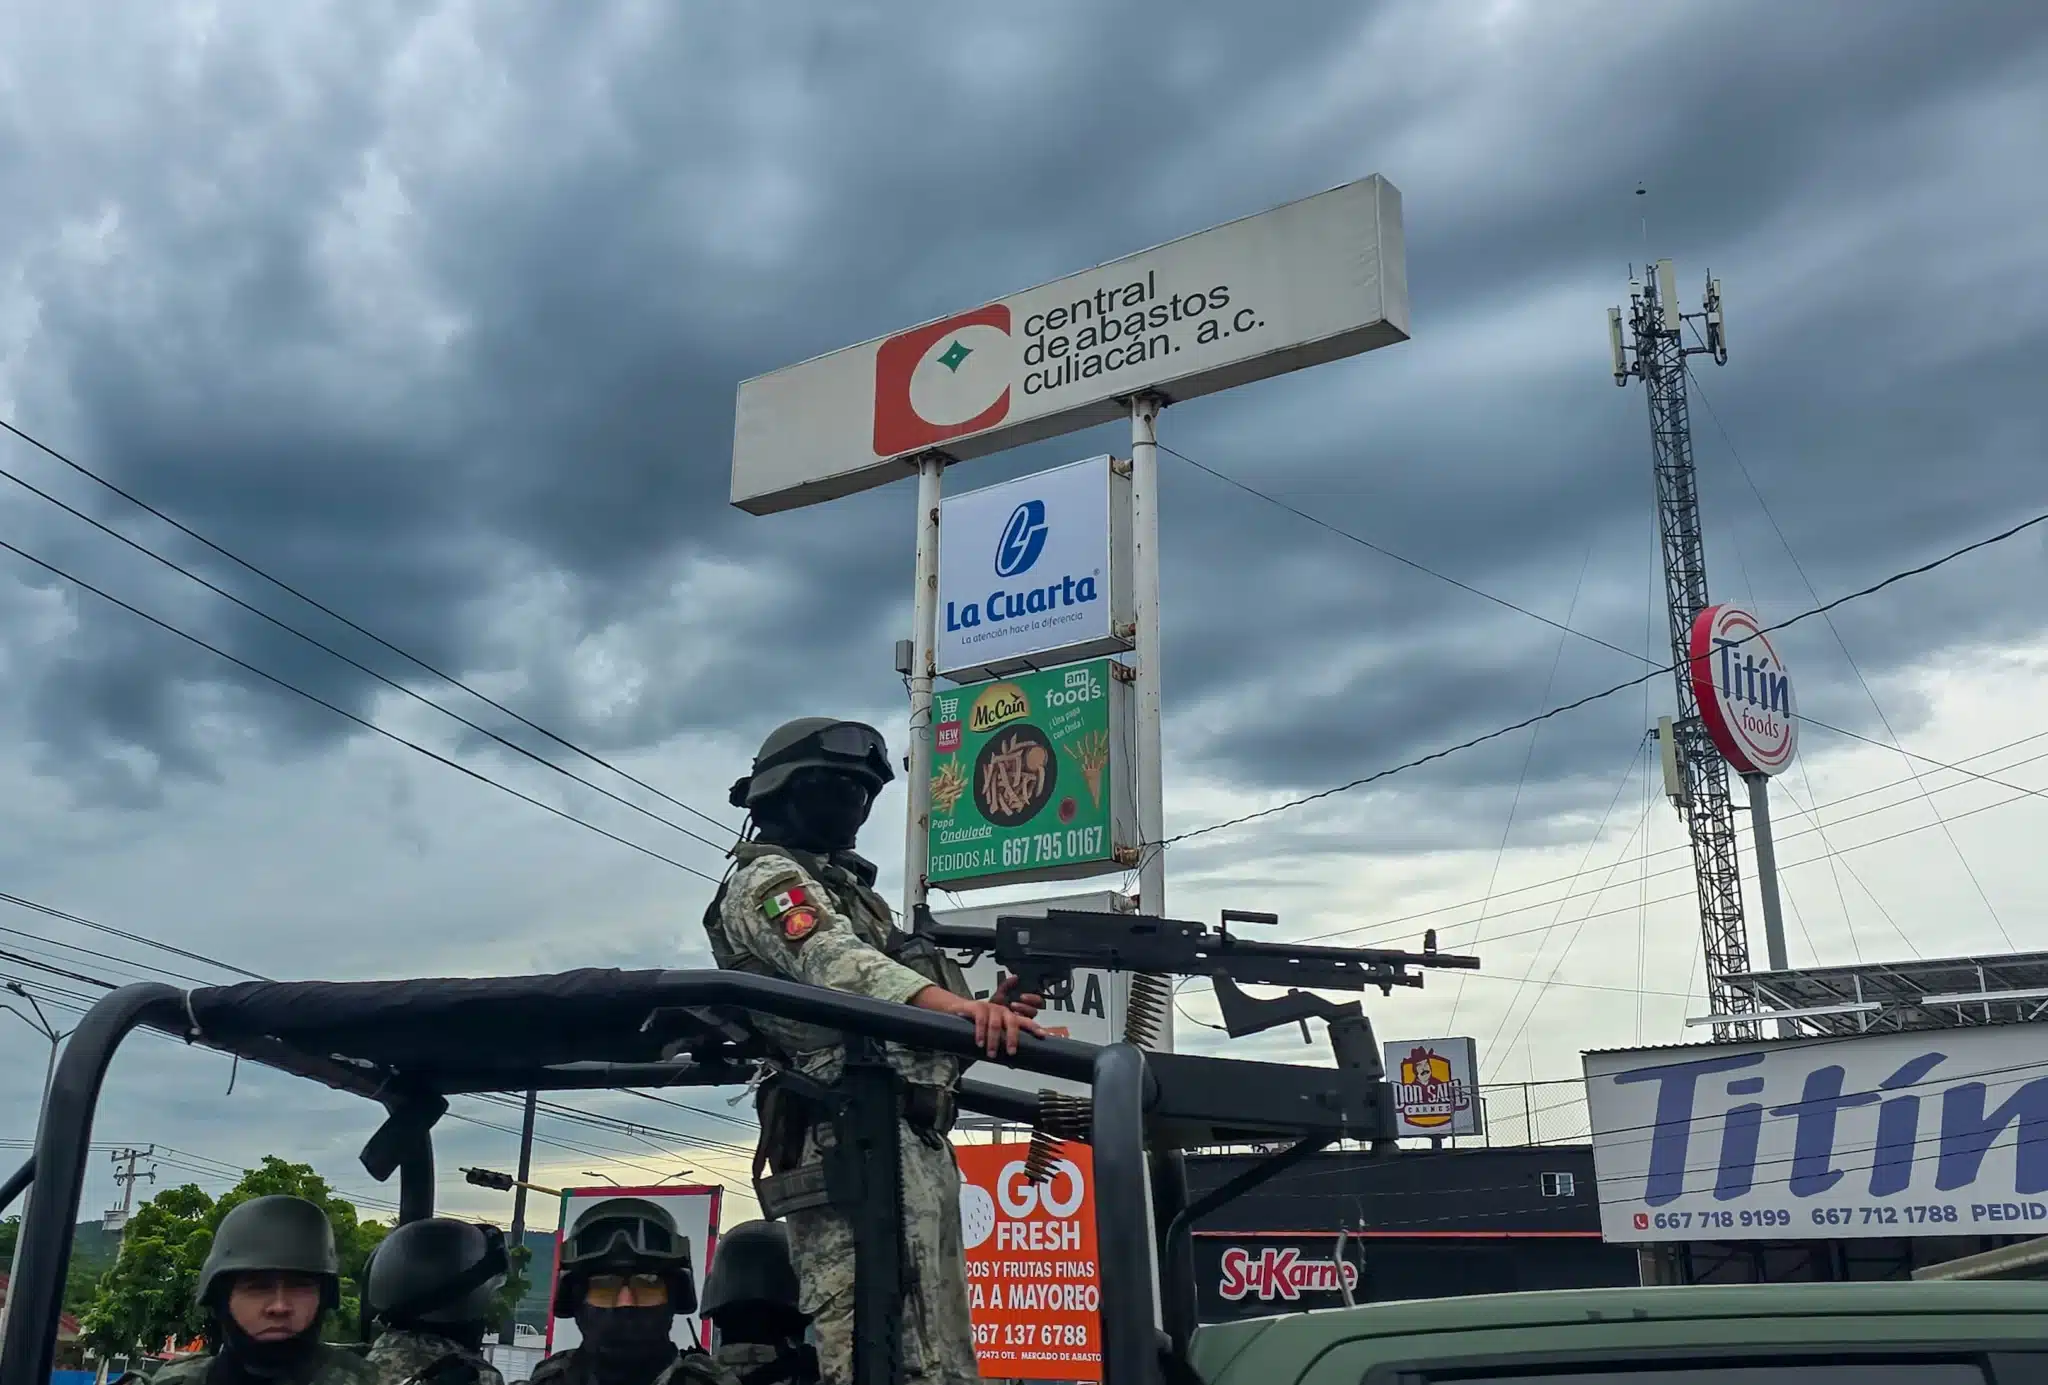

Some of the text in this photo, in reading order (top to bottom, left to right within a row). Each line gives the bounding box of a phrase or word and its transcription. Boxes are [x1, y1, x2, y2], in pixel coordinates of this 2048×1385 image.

[1024, 270, 1155, 337] central
[1023, 285, 1231, 366] de abastos
[1023, 307, 1265, 395] culiacán. a.c.
[947, 575, 1098, 632] La Cuarta
[962, 636, 972, 644] La
[1010, 619, 1030, 635] hace
[1032, 620, 1040, 630] la
[1042, 611, 1084, 628] diferencia
[1067, 672, 1086, 684] am
[1712, 638, 1790, 718] Titín
[973, 699, 1026, 727] McCain
[1742, 708, 1779, 738] foods
[939, 728, 959, 740] NEW
[932, 819, 954, 829] Papa
[940, 826, 993, 842] Ondulada
[931, 825, 1103, 872] PEDIDOS AL 667 795 0167
[1408, 1105, 1451, 1114] CARNES
[997, 1159, 1085, 1218] GO
[1654, 1212, 1693, 1229] 667
[1698, 1210, 1734, 1228] 718
[1739, 1208, 1791, 1227] 9199
[1811, 1207, 1853, 1225] 667
[1859, 1206, 1899, 1225] 712
[1903, 1204, 1958, 1223] 1788
[997, 1221, 1080, 1250] FRESH
[992, 1261, 1001, 1277] Y
[1003, 1261, 1052, 1277] FRUTAS
[1055, 1261, 1095, 1278] FINAS
[989, 1284, 1003, 1309] A
[1008, 1284, 1100, 1312] MAYOREO
[1004, 1324, 1036, 1344] 137
[1041, 1325, 1087, 1346] 6788
[1001, 1351, 1017, 1360] OTE.
[1021, 1351, 1058, 1360] MERCADO
[1060, 1353, 1070, 1361] DE
